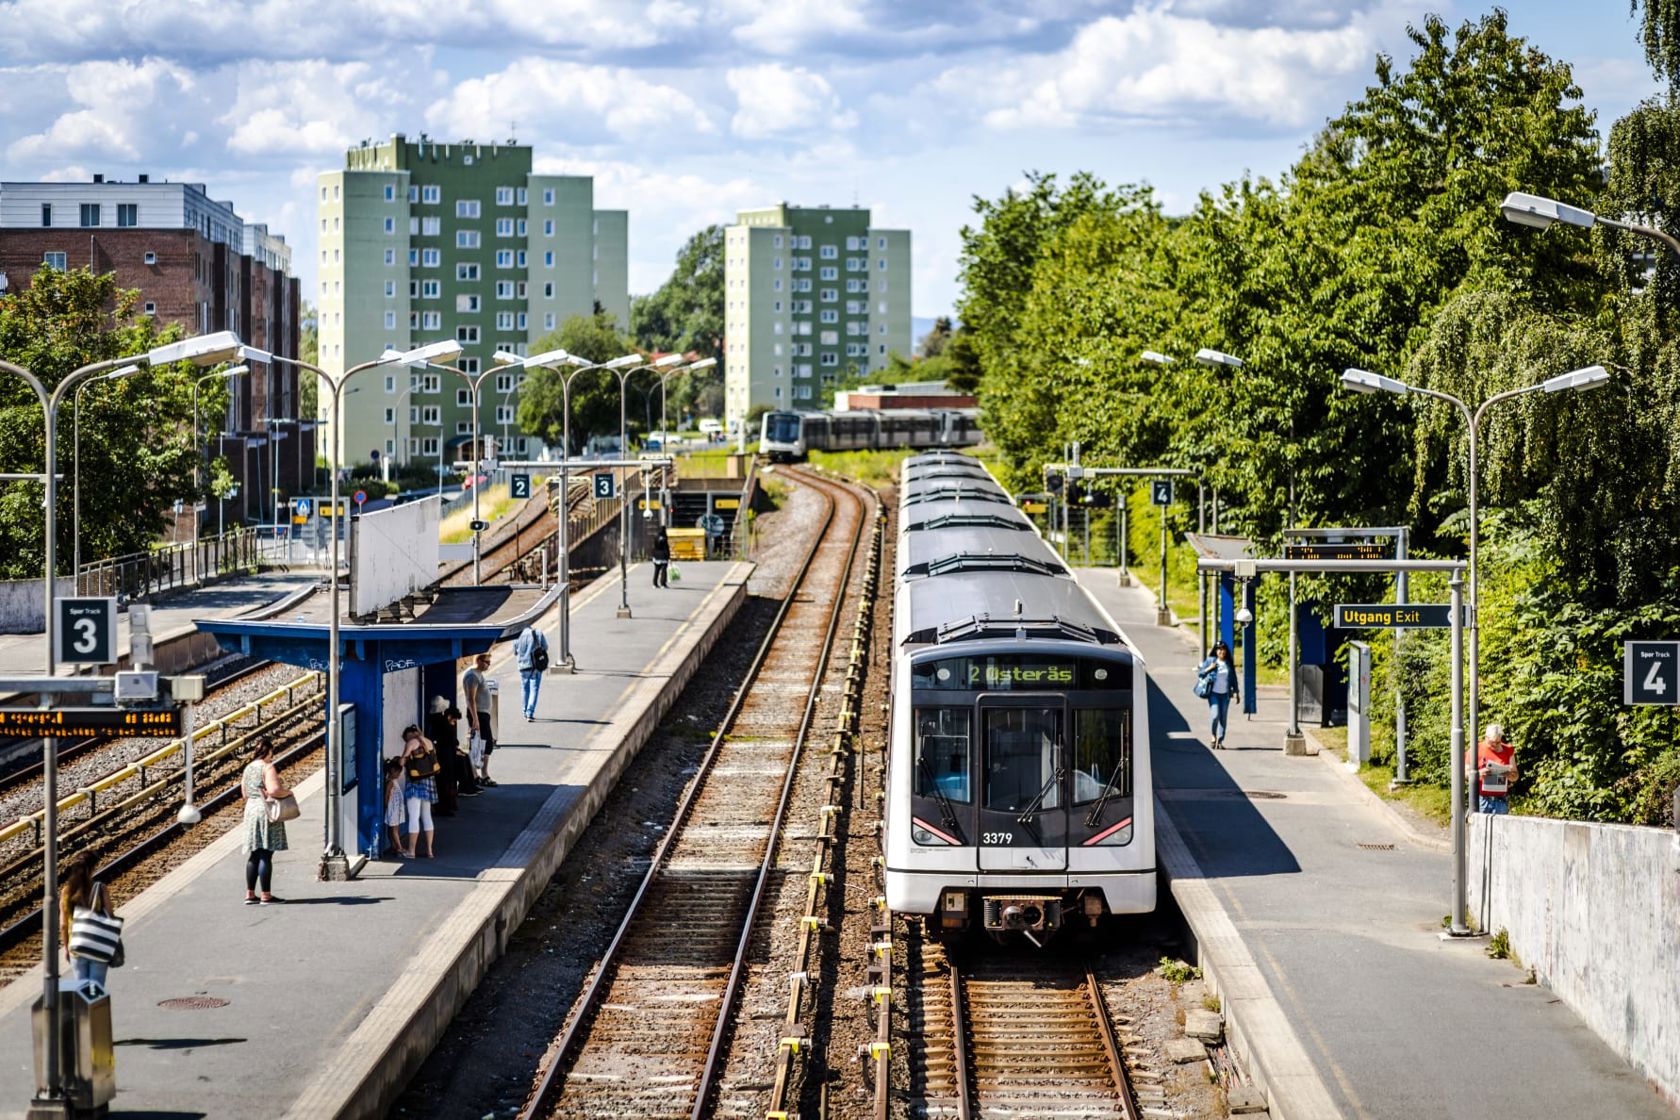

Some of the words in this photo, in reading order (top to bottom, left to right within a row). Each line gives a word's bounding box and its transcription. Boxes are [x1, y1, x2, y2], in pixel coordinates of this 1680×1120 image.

[516, 481, 526, 496] 2
[600, 480, 610, 495] 3
[1158, 488, 1168, 502] 4
[1344, 610, 1391, 625] Utgang
[1396, 610, 1420, 622] Exit
[73, 618, 97, 654] 3
[1641, 651, 1654, 659] Spor
[971, 666, 980, 682] 2
[1643, 661, 1667, 695] 4
[983, 832, 1013, 845] 3379
